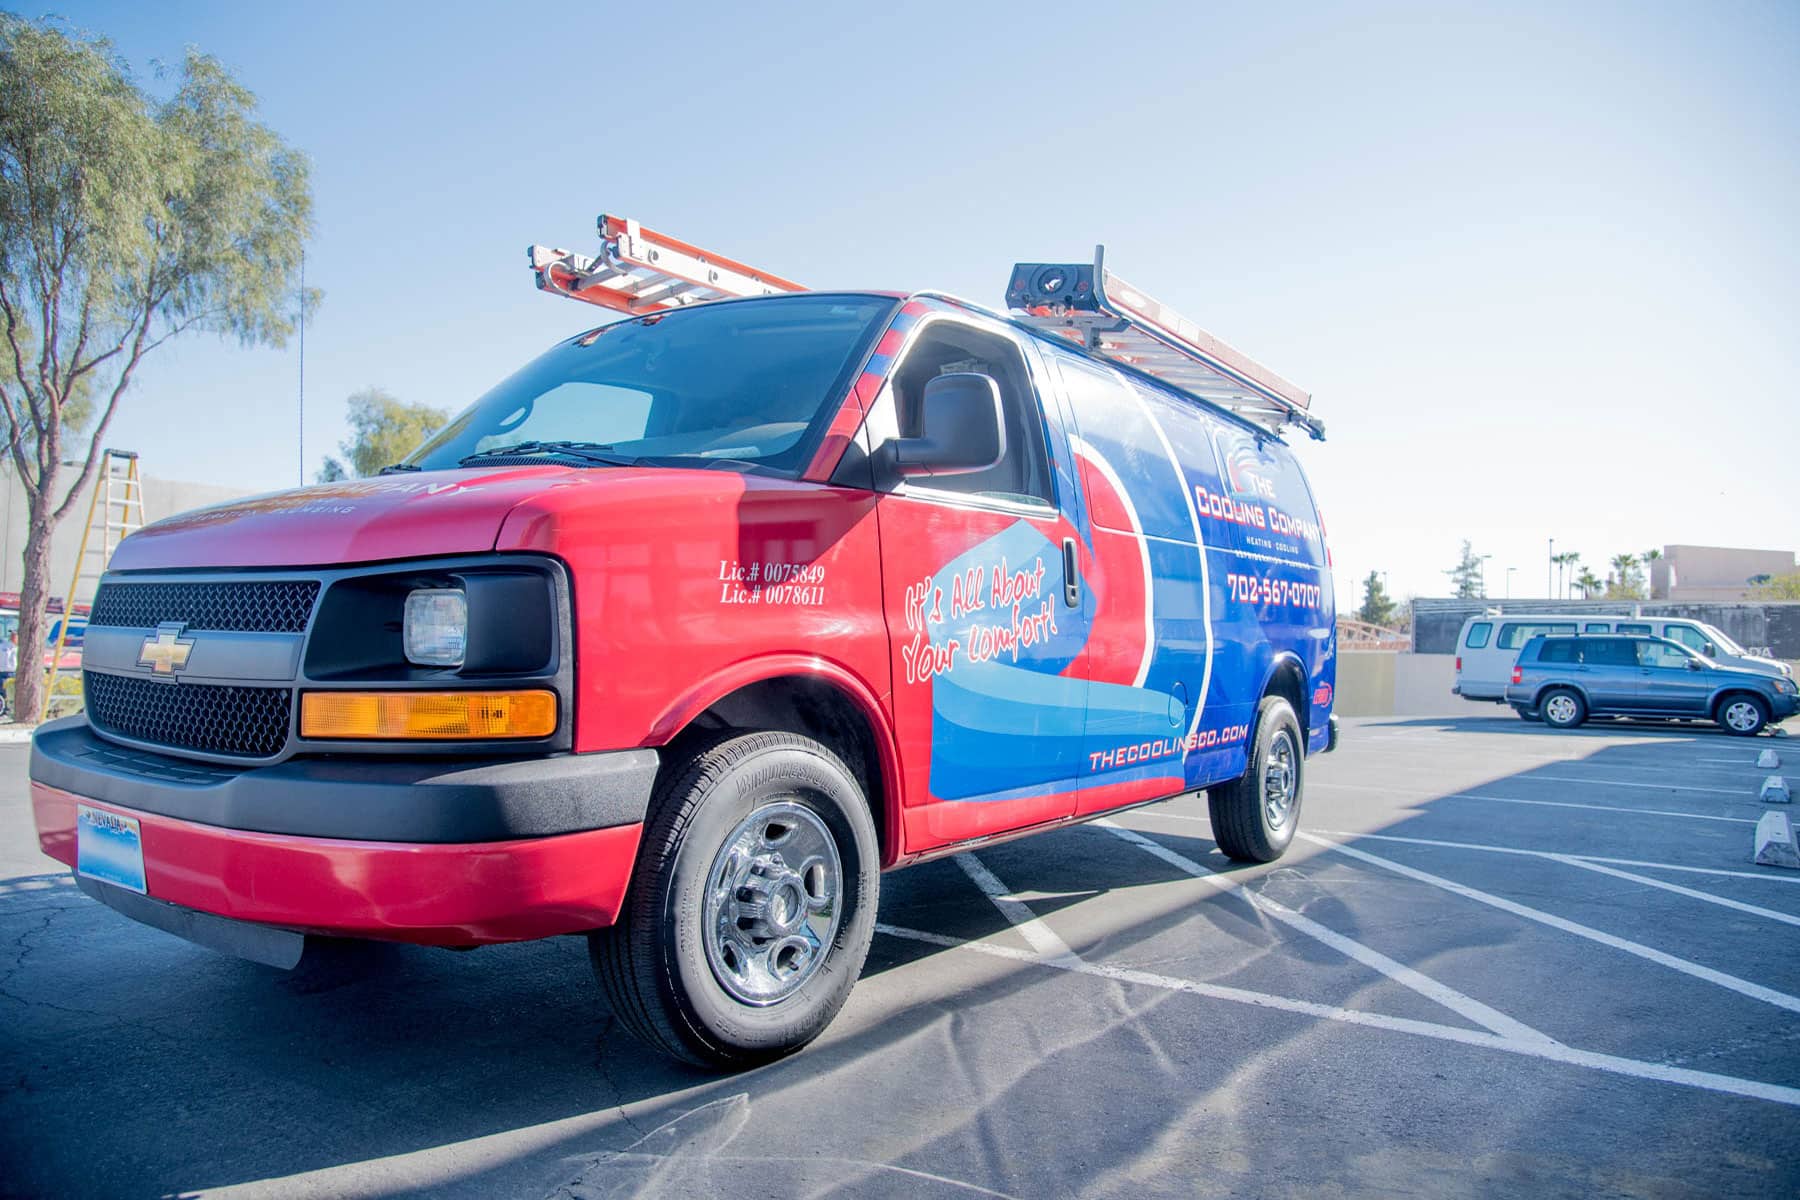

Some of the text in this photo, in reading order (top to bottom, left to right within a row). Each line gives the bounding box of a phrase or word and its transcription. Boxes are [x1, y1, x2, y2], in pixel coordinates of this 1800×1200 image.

[1247, 472, 1277, 499] THE
[1194, 485, 1266, 530] COOLING
[1246, 535, 1299, 554] HEATING COOLING
[763, 563, 825, 584] 0075849
[1227, 573, 1320, 609] 702-567-0707
[765, 585, 825, 605] 0078611
[905, 556, 1046, 631] It's All About
[902, 593, 1058, 684] Your Comfort!
[1089, 724, 1249, 771] THECOOLINGCO.COM
